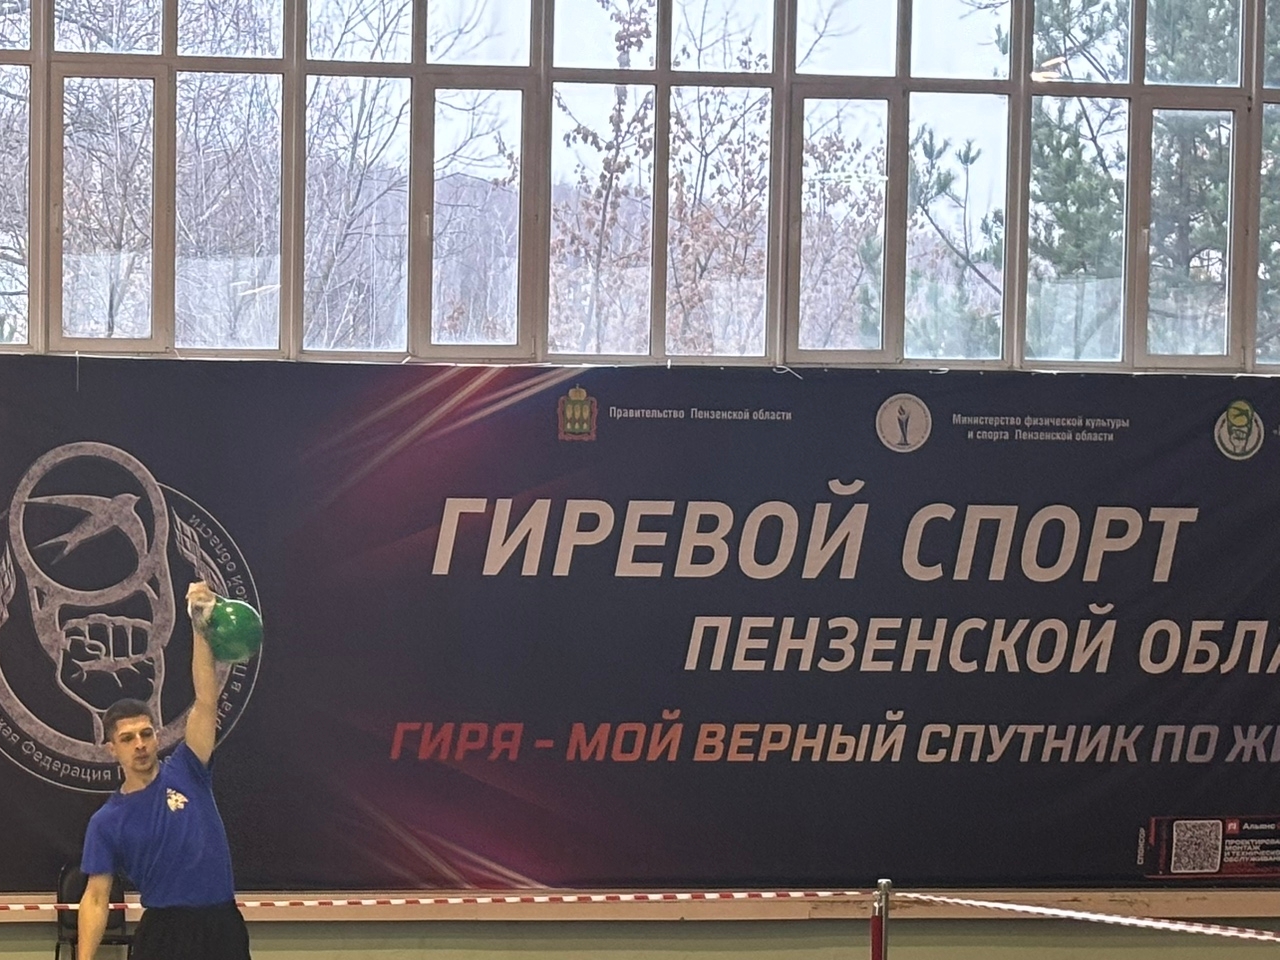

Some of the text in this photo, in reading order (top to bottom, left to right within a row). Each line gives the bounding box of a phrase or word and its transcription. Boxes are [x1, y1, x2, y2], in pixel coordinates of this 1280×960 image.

[609, 406, 792, 421] Правительство Пензенской области
[952, 413, 1130, 429] Министерство физической культуры
[976, 431, 1009, 442] спорта
[1014, 429, 1073, 441] Пензенской
[1075, 430, 1114, 442] области
[431, 479, 1199, 583] ГИРЕВОЙ СПОРТ
[683, 602, 1117, 674] ПЕНЗЕНСКОЙ
[390, 721, 523, 760] ГИРЯ
[565, 709, 682, 762] МОЙ
[692, 710, 907, 763] ВЕРНЫЙ
[916, 723, 1145, 763] СПУТНИК
[1150, 724, 1220, 763] ПО
[21, 739, 113, 783] Федерация
